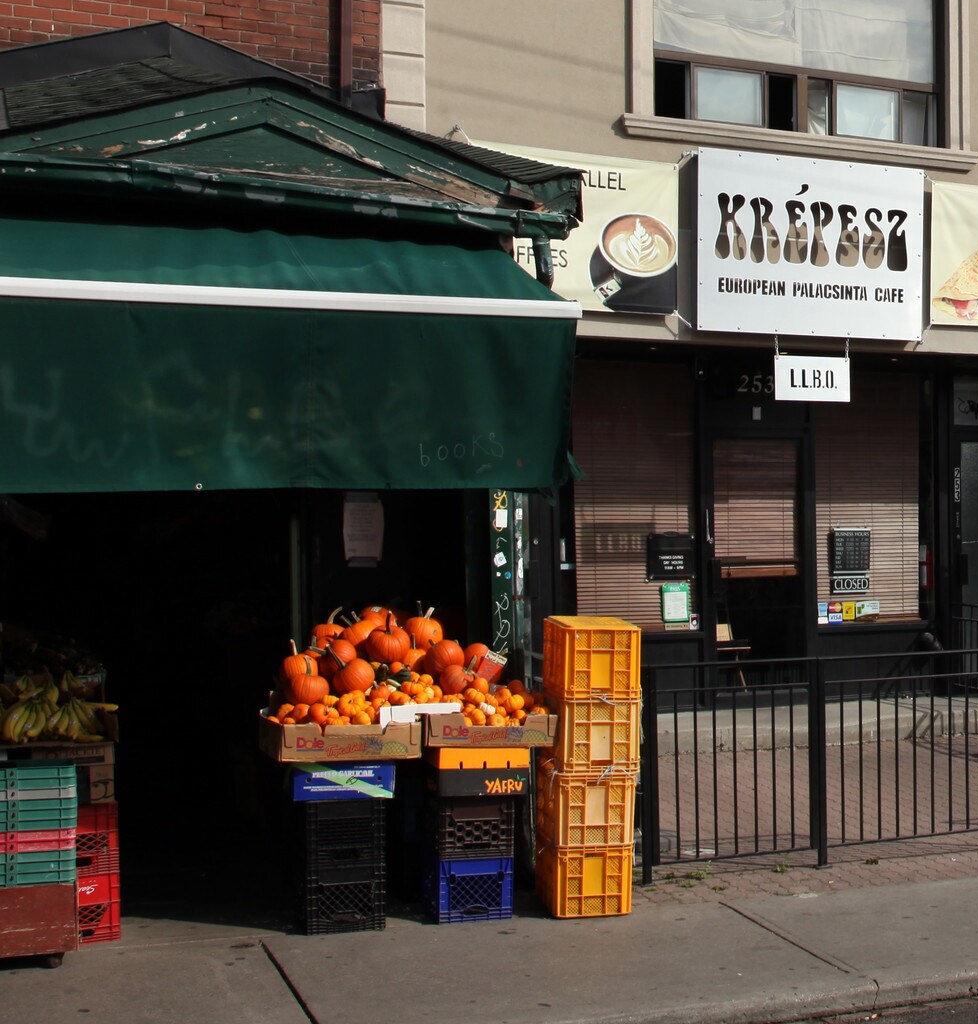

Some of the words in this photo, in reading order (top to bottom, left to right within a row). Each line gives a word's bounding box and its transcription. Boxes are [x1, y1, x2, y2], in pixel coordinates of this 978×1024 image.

[714, 183, 909, 272] KRÉPESZ
[717, 276, 786, 297] EUROPEAN
[792, 281, 868, 302] PALACSINTA
[874, 287, 904, 304] CAFE
[789, 368, 838, 389] L.L.B.O.
[834, 578, 869, 590] CLOSED
[442, 725, 469, 737] Dole
[296, 736, 325, 750] Dole
[484, 777, 524, 794] YAFRU
